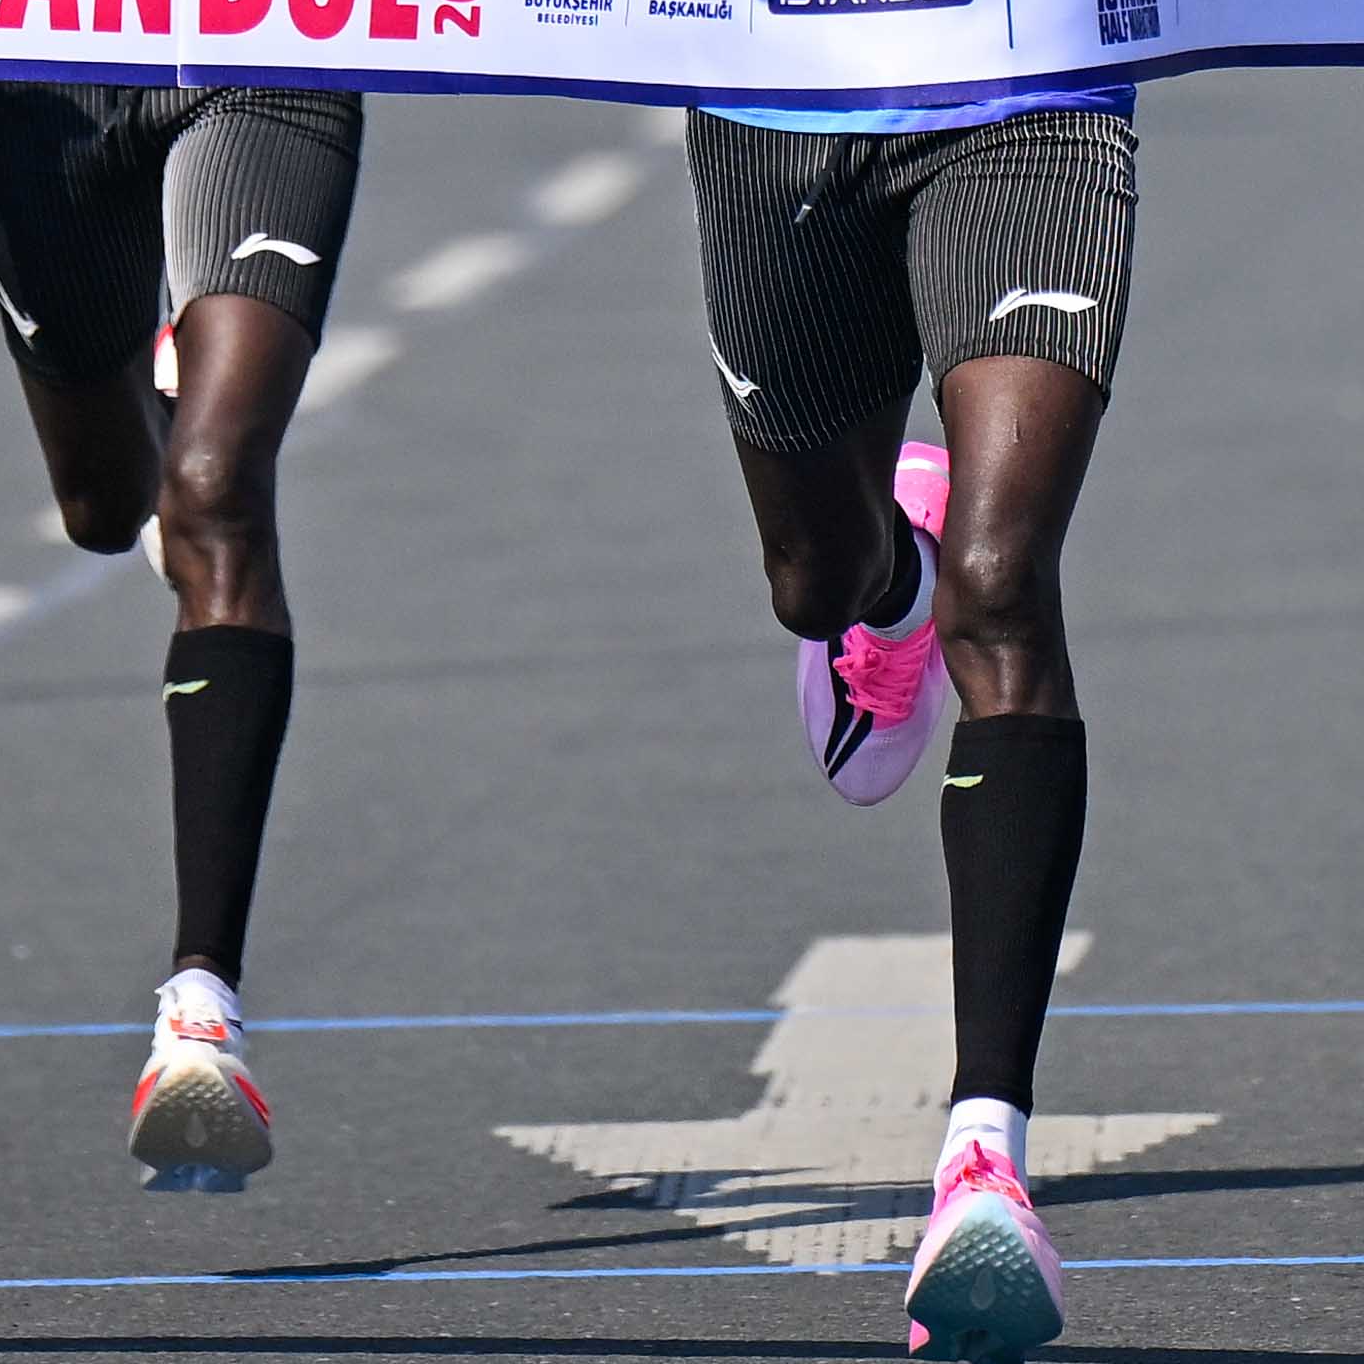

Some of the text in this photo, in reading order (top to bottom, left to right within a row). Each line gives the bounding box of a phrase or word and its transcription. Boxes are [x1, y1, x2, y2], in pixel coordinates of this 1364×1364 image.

[537, 12, 598, 26] BELEDİYESİ
[649, 0, 732, 20] BAŞKANLIĞI
[1098, 10, 1129, 46] HALF
